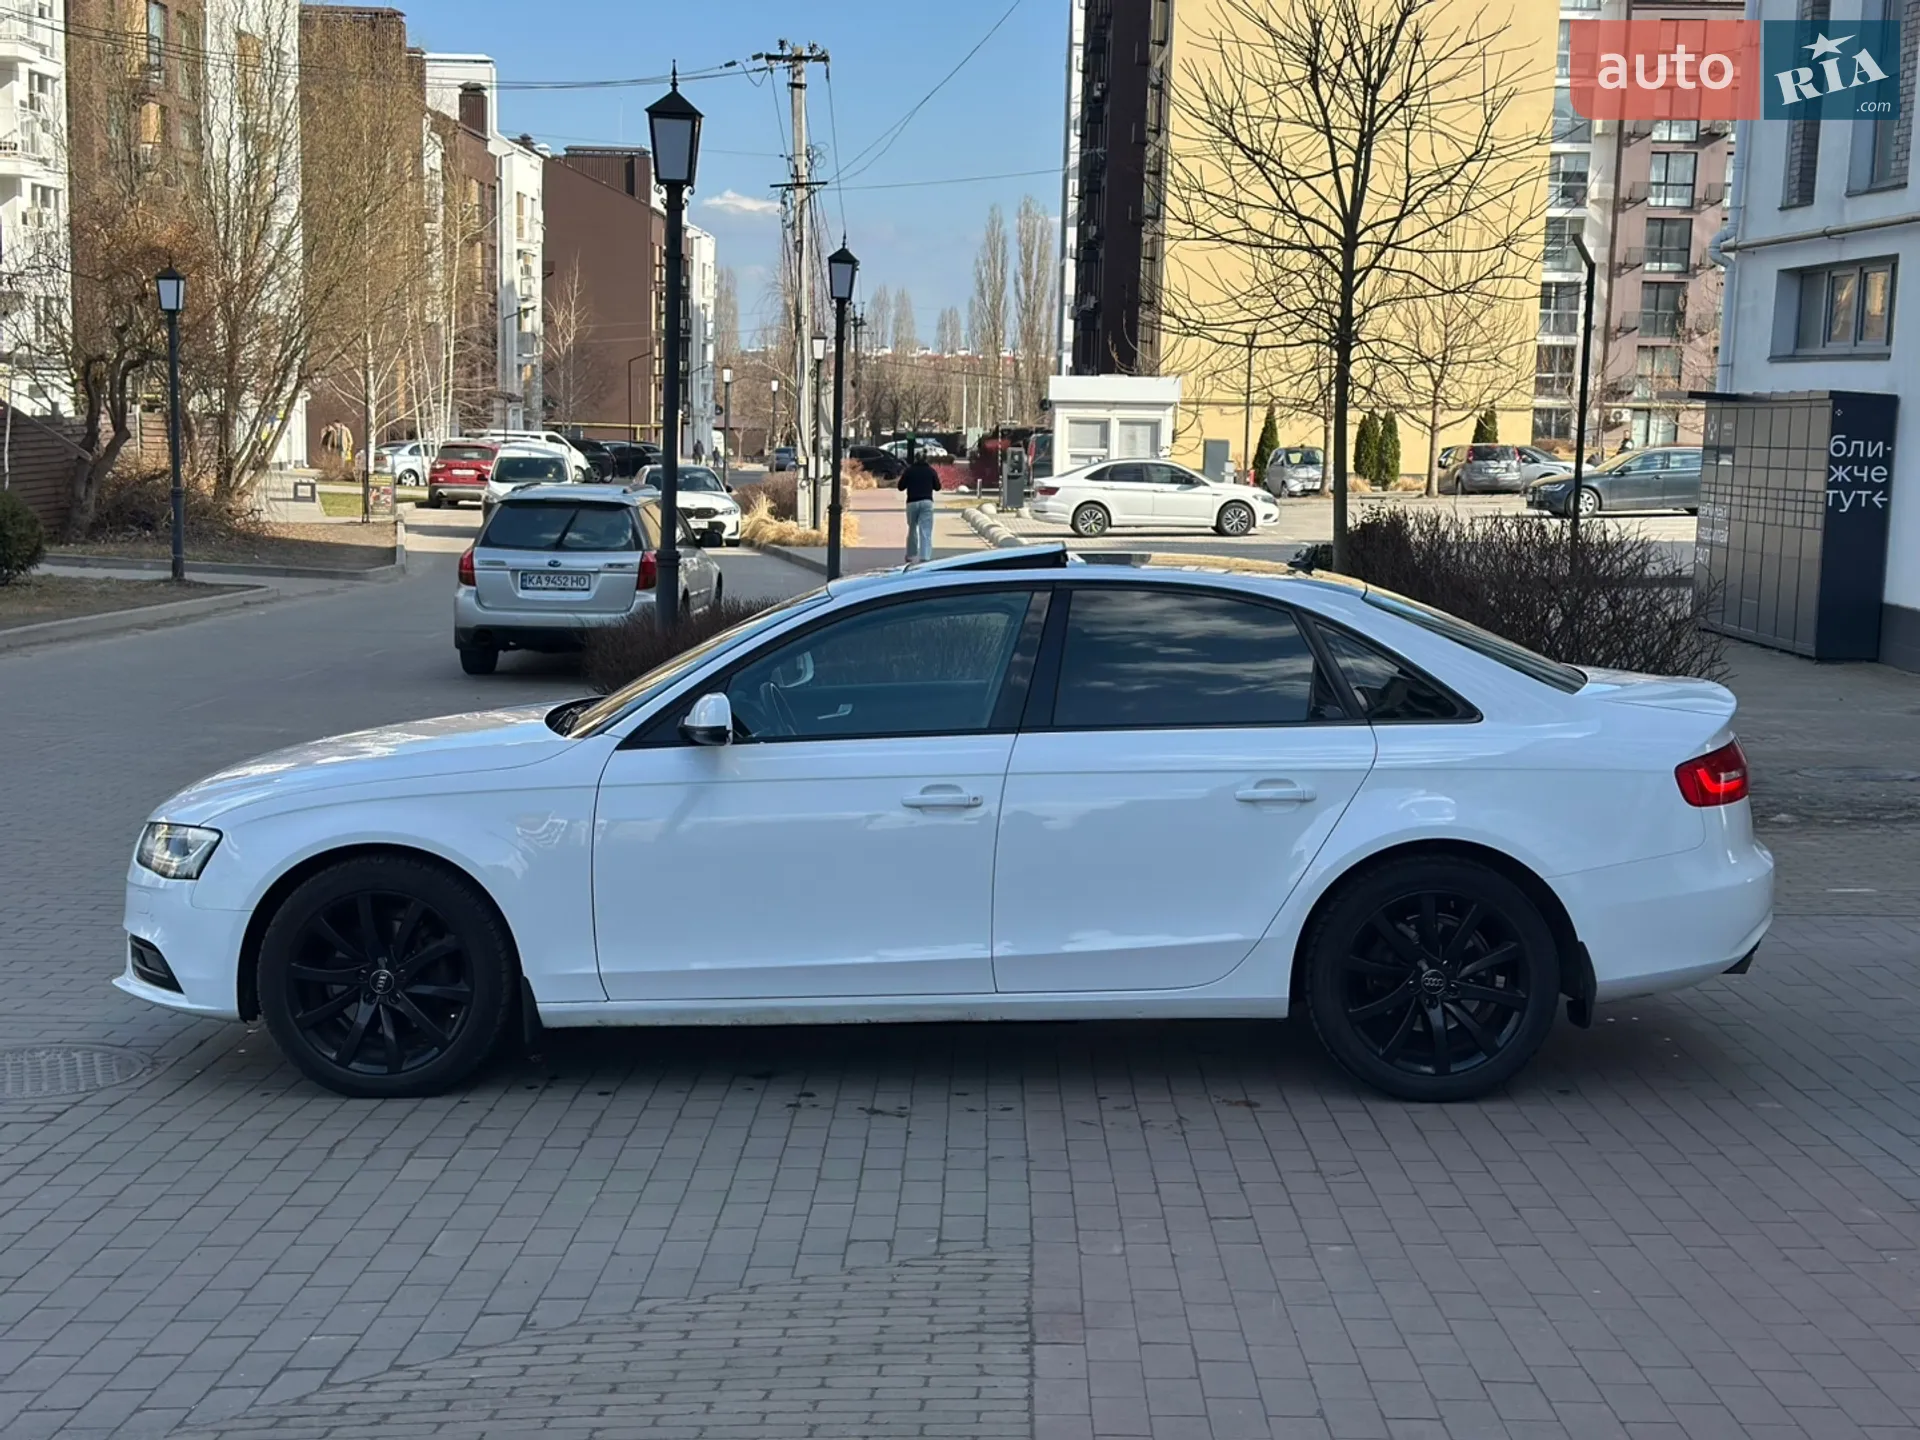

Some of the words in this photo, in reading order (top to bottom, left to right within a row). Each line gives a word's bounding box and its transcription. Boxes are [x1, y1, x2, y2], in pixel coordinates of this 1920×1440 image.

[1830, 434, 1892, 457] бли-
[1828, 465, 1888, 483] жче
[1826, 490, 1872, 513] тут
[528, 576, 542, 585] KA
[545, 576, 569, 586] 9452
[571, 576, 586, 587] HO
